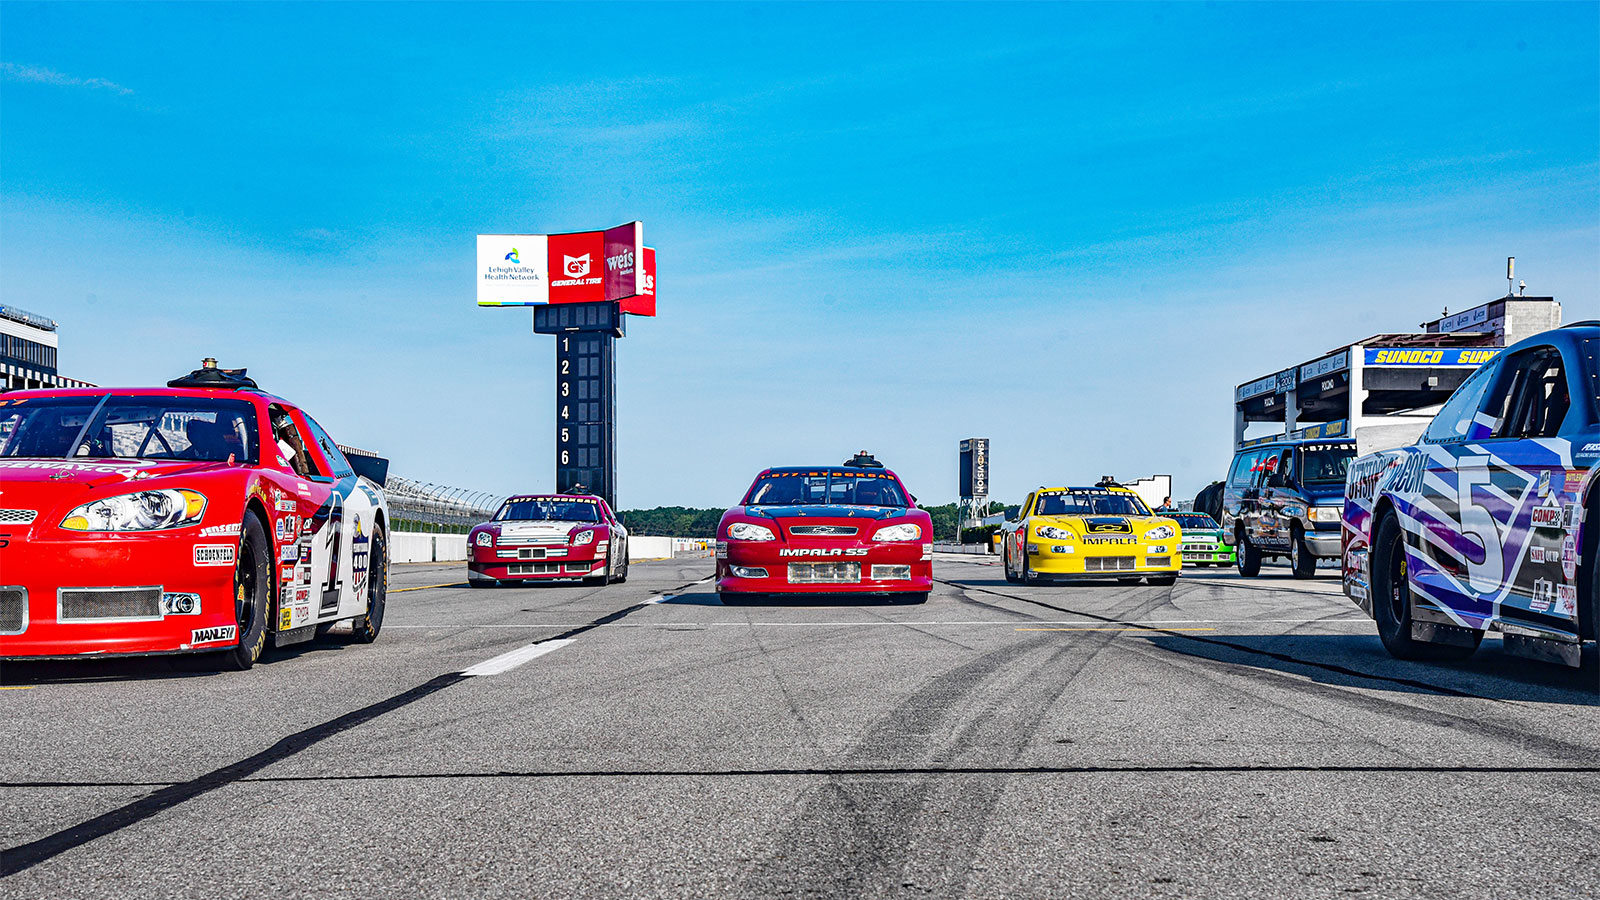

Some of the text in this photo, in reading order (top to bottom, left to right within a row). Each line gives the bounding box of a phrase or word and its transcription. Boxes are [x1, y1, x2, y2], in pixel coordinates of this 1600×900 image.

[567, 260, 587, 273] GT
[606, 248, 634, 271] weis
[488, 266, 535, 274] Lehigh Valley
[551, 277, 603, 287] GENERAL TIRE
[562, 337, 569, 352] 1
[1374, 350, 1501, 364] SUNOCO SUN
[561, 360, 570, 374] 2
[561, 382, 570, 397] 3
[561, 405, 570, 420] 4
[561, 428, 570, 442] 5
[561, 450, 570, 464] 6
[1532, 509, 1555, 522] COMP
[1456, 454, 1505, 595] 5
[196, 549, 233, 561] SCHOENFELD
[320, 490, 345, 618] 1
[779, 548, 869, 557] IMPALA SS
[1531, 549, 1544, 561] SAFE
[353, 554, 368, 569] 400
[194, 626, 230, 643] MANLEY
